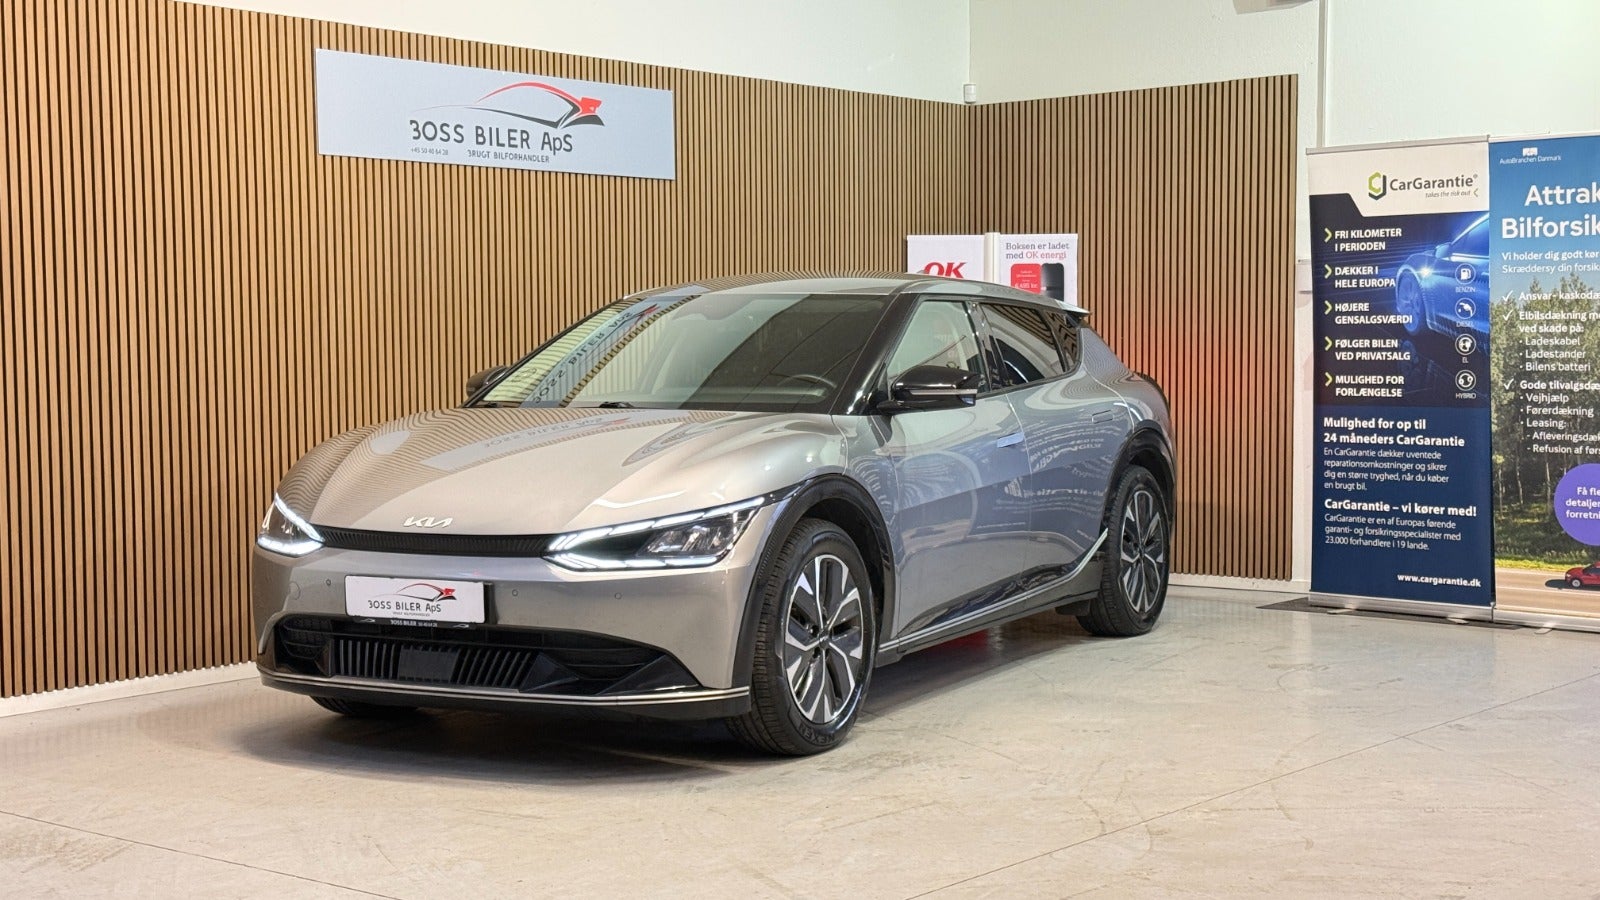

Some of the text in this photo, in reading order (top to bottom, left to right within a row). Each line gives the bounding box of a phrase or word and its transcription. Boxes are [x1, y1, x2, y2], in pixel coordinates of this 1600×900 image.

[475, 125, 530, 150] BILER
[540, 131, 573, 156] ApS
[494, 152, 550, 163] BILFORHANDLER
[1335, 228, 1402, 239] FRI KILOMETER
[1048, 242, 1070, 250] ladet
[1335, 241, 1386, 252] I PERIODEN
[1026, 251, 1039, 259] OK
[1040, 251, 1067, 260] energi
[1502, 252, 1511, 260] Vi
[1513, 251, 1543, 260] holder
[1544, 250, 1559, 261] dig
[1561, 250, 1583, 260] godt
[924, 262, 967, 278] OK
[1335, 266, 1378, 276] DÆKKER I
[1502, 264, 1555, 274] Skræddersy
[1558, 263, 1572, 272] din
[1335, 278, 1396, 288] HELE EUROPA
[1519, 292, 1557, 300] Ansvar-
[1335, 302, 1370, 312] HØJERE
[1335, 315, 1412, 324] GENSALGSVÆRDI
[1519, 310, 1586, 322] Elbilsdækning
[1519, 323, 1584, 334] ved skade på:
[1335, 339, 1398, 348] FØLGER BILEN
[1526, 337, 1580, 346] Ladeskabel
[1335, 351, 1411, 360] VED PRIVATSALG
[1526, 350, 1586, 358] Ladestander
[1526, 362, 1591, 371] Bilens batteri
[1335, 375, 1404, 384] MULIGHED FOR
[1520, 380, 1546, 389] Gode
[1336, 387, 1403, 397] FORLÆNGELSE
[1526, 393, 1569, 404] Vejhjælp
[1526, 406, 1594, 418] Førerdækning
[1324, 417, 1426, 431] Mulighed for op til
[1526, 418, 1567, 430] Leasing:
[1324, 433, 1465, 446] 24 måneders CarGarantie
[1334, 448, 1376, 457] CarGarantie
[1378, 449, 1404, 458] dækker
[1406, 451, 1442, 459] uventede
[1532, 444, 1572, 453] Refusion
[1574, 446, 1584, 454] af
[1324, 460, 1447, 472] reparationsomkostninger og sikrer
[1324, 470, 1336, 480] dig
[1370, 472, 1401, 482] tryghed,
[1415, 474, 1426, 482] du
[1427, 474, 1449, 483] køber
[1335, 482, 1355, 491] brugt
[1577, 486, 1588, 496] Få
[1324, 498, 1390, 512] CarGarantie
[1402, 503, 1411, 513] vi
[1415, 503, 1444, 514] kører
[1448, 504, 1477, 517] med!
[1324, 513, 1366, 524] CarGarantie
[1387, 516, 1395, 525] af
[1396, 517, 1425, 528] Europas
[1427, 519, 1456, 529] førende
[1325, 525, 1461, 541] garanti- og forsikringsspecialister med
[1325, 536, 1348, 545] 23.000
[1350, 536, 1391, 548] forhandlere
[1397, 540, 1406, 548] 19
[1407, 541, 1429, 550] lande.
[1397, 574, 1481, 587] www.cargarantie.dk
[396, 601, 421, 611] BILER
[425, 603, 442, 614] ApS
